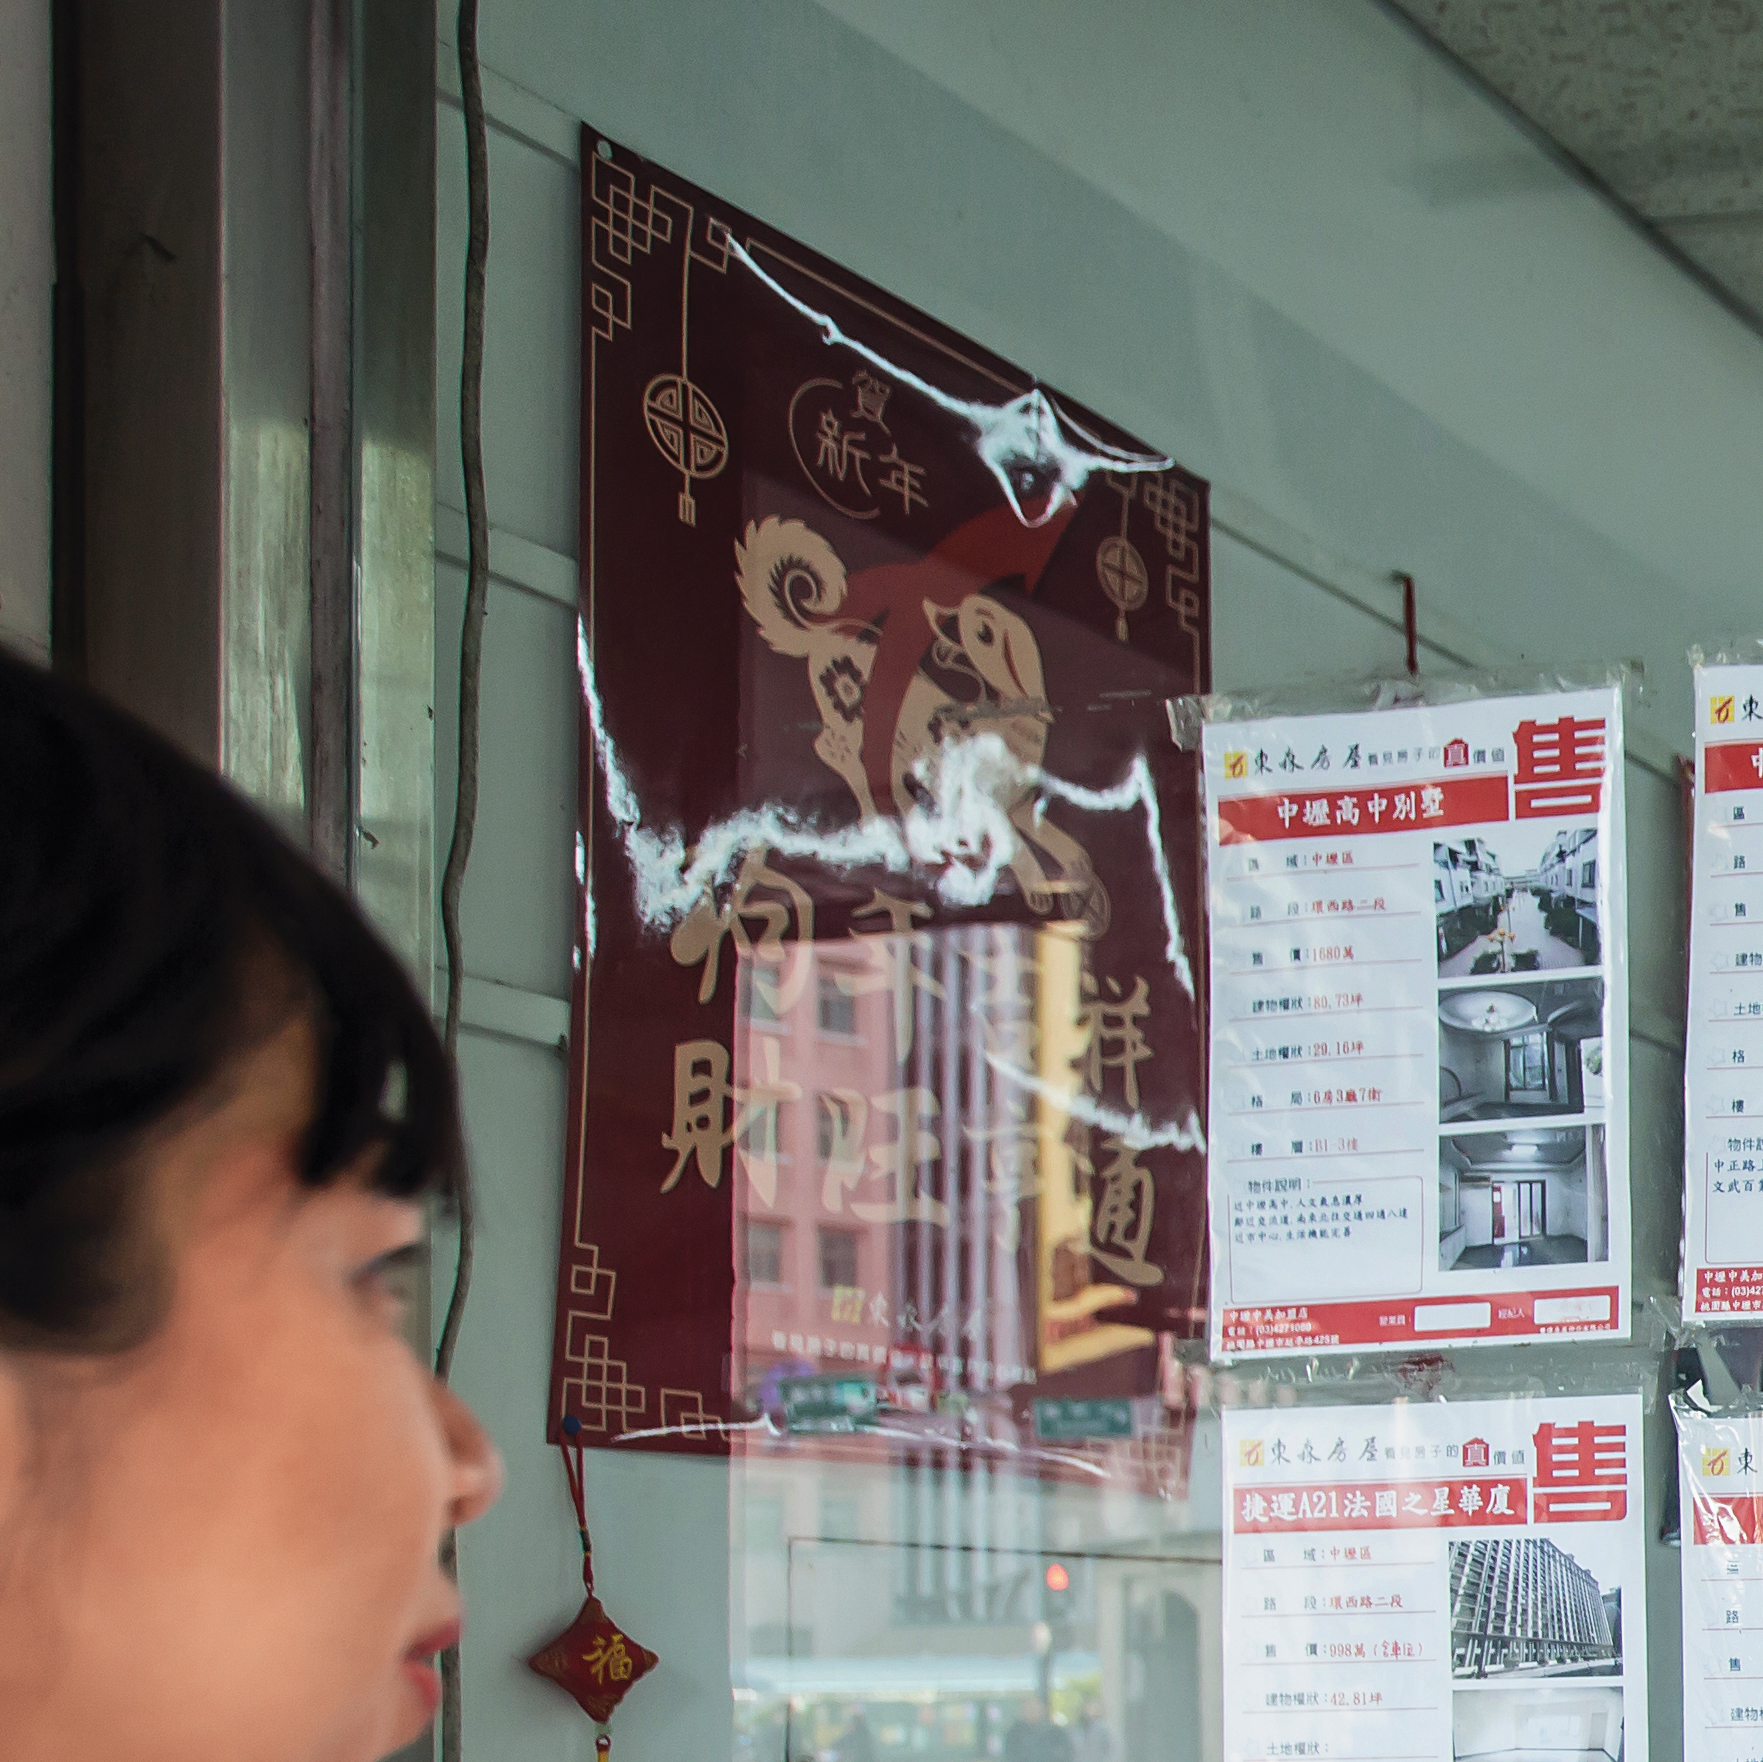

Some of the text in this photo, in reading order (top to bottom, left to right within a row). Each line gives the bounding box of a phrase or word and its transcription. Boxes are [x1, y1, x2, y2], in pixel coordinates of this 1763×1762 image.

[1254, 742, 1362, 775] 東森房屋
[1512, 716, 1606, 820] 售
[1277, 787, 1445, 829] 中壢高中別墅
[1270, 1436, 1379, 1464] 東森房屋
[1532, 1420, 1627, 1523] 售
[1241, 1483, 1515, 1522] 捷運A21法國之星華廈
[583, 1632, 633, 1686] 福
